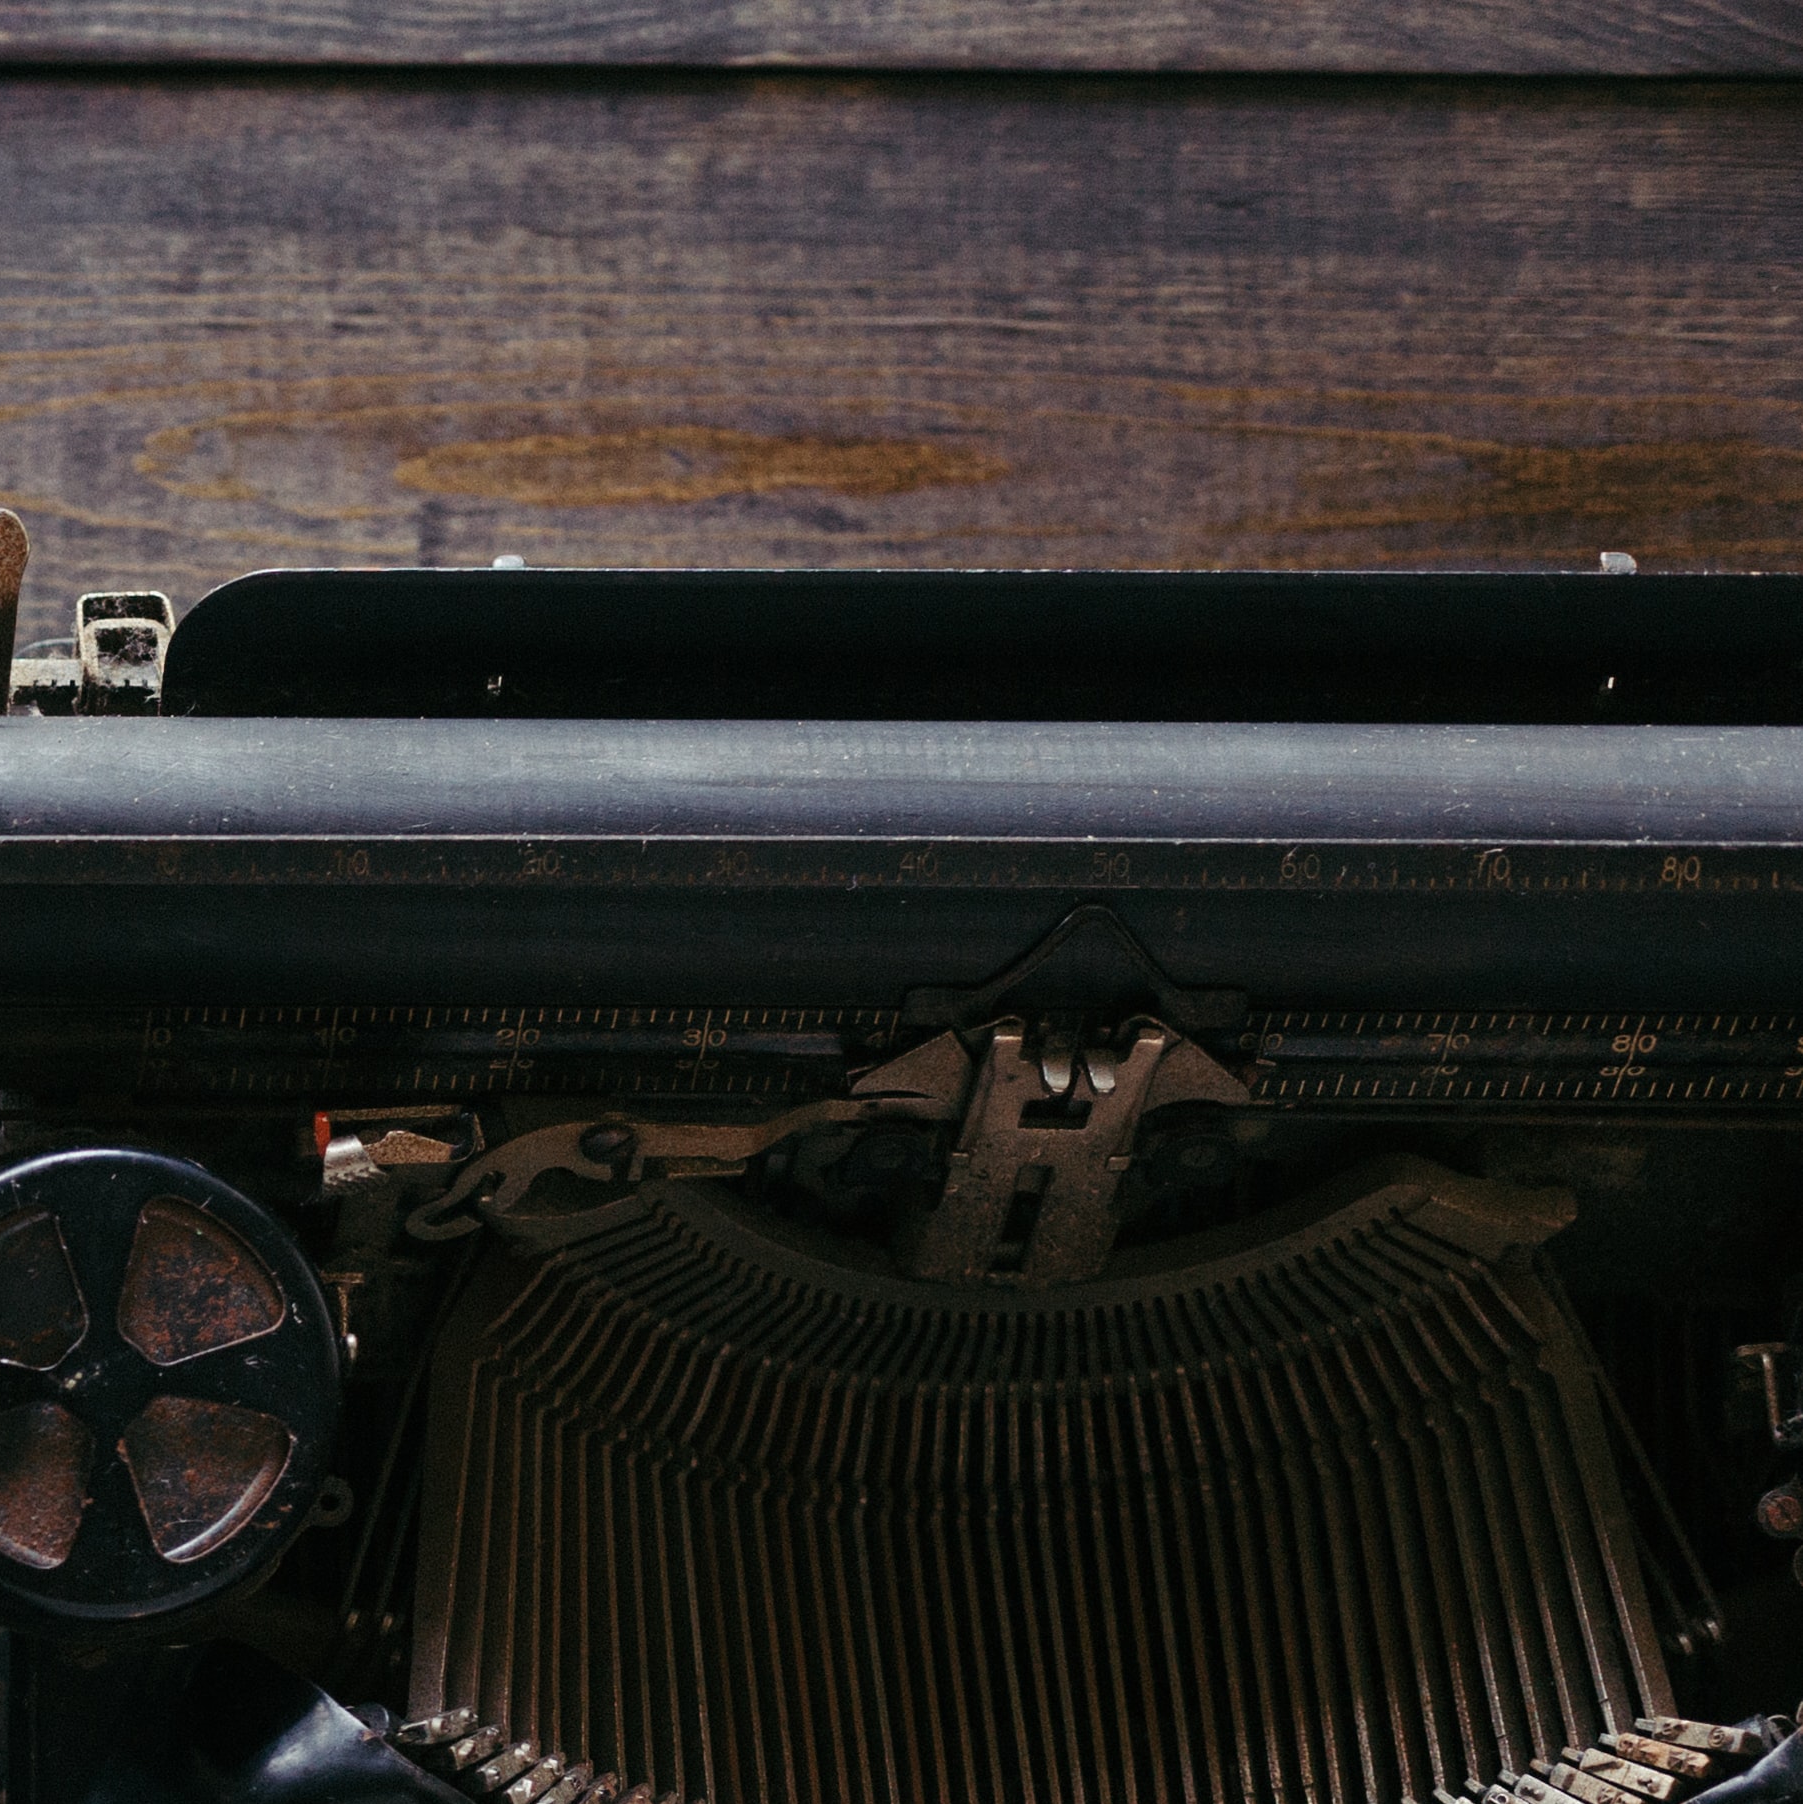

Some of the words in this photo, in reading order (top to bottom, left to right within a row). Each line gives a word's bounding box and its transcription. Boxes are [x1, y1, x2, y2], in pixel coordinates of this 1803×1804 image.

[899, 851, 938, 877] 40
[1092, 852, 1130, 878] 50
[1280, 852, 1321, 879] 60
[1473, 853, 1511, 881] 70
[1661, 855, 1702, 882] 80
[495, 1028, 541, 1047] 20
[682, 1028, 728, 1047] 30
[1239, 1032, 1283, 1051] 60
[1427, 1033, 1471, 1051] 70
[1611, 1033, 1658, 1053] 80
